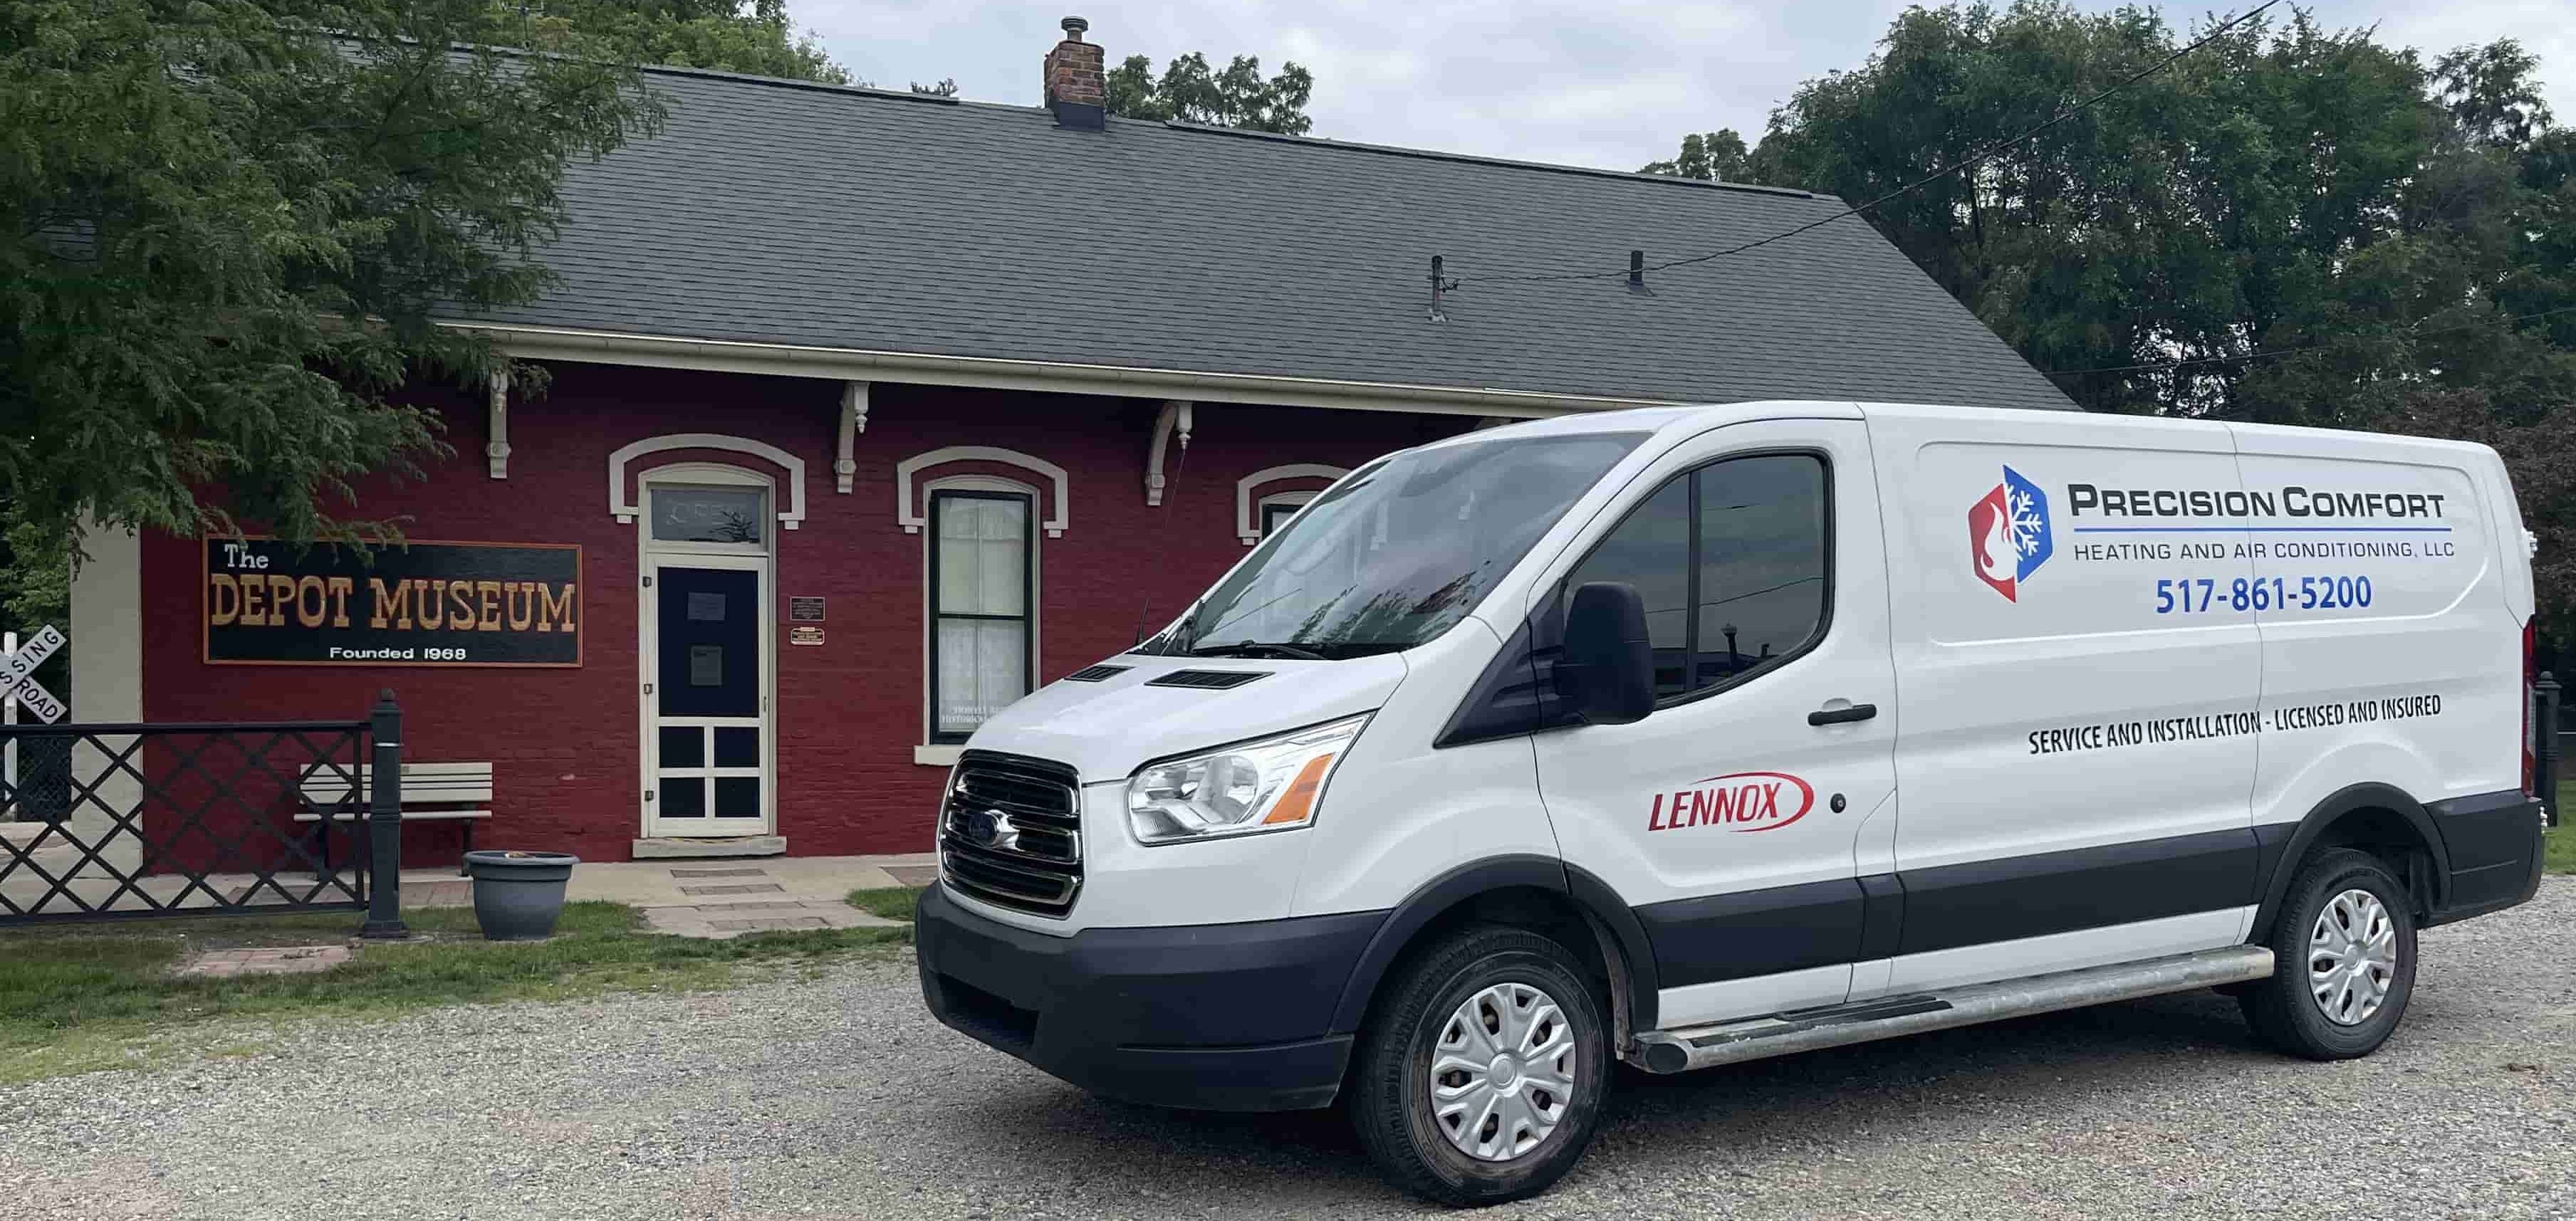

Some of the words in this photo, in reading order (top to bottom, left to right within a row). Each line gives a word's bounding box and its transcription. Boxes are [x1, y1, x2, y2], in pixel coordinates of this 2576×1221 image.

[2067, 483, 2276, 517] PRECISION
[2282, 486, 2445, 518] COMFORT
[224, 543, 268, 569] The
[2074, 543, 2171, 561] HEATING
[2180, 543, 2226, 559] AND
[2233, 543, 2266, 558] AIR
[2274, 542, 2418, 558] CONDITIONING,
[2424, 542, 2455, 557] LLC
[210, 572, 353, 628] DEPOT
[370, 577, 575, 632] MUSEUM
[2156, 575, 2372, 614] 517-861-5200
[329, 646, 414, 659] Founded
[424, 647, 467, 661] 1968
[2028, 725, 2103, 755] SERVICE
[2107, 721, 2143, 748] AND
[2148, 711, 2262, 744] INSTALLATION
[2275, 703, 2344, 731] LICENSED
[2348, 700, 2378, 724] AND
[2382, 693, 2441, 720] INSURED
[1647, 782, 1782, 832] LENNOX
